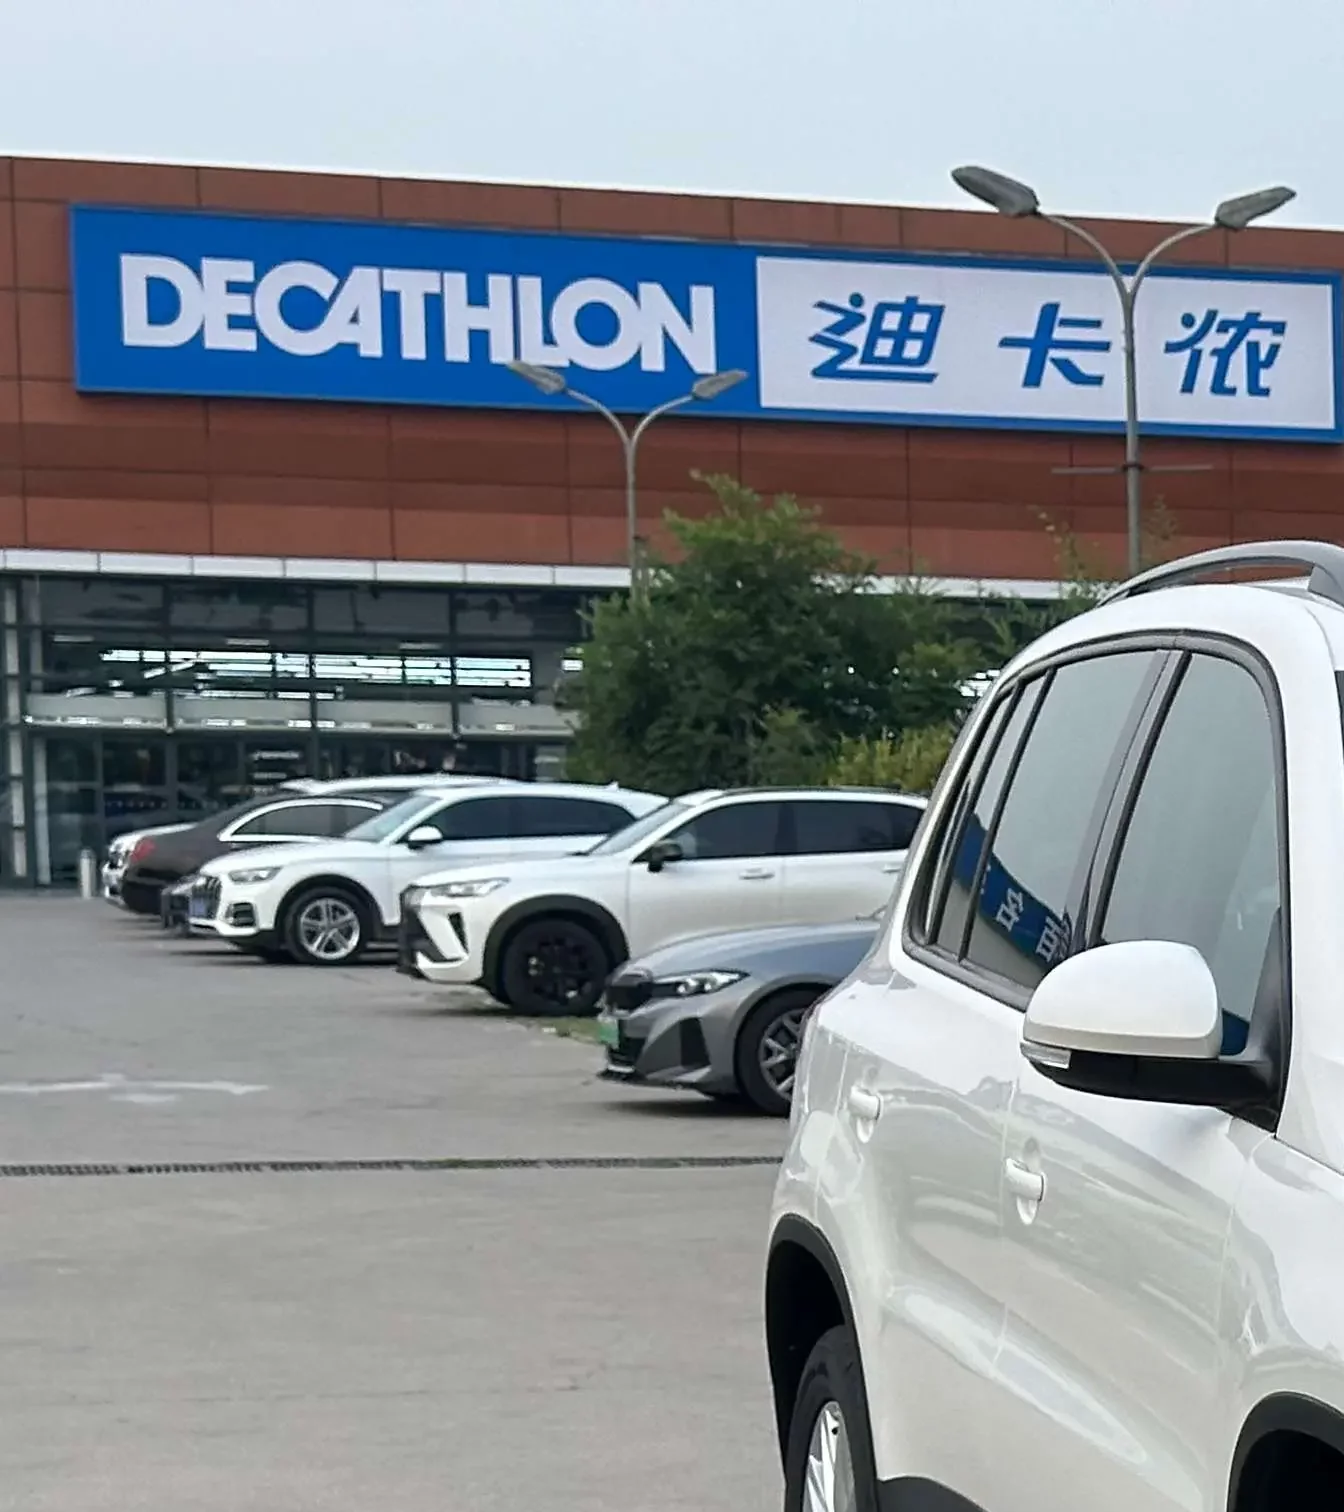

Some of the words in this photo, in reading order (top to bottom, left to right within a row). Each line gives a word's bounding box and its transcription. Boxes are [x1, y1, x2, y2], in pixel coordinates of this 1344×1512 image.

[119, 253, 717, 376] DECATHLON
[808, 291, 1288, 398] 迪卡侬
